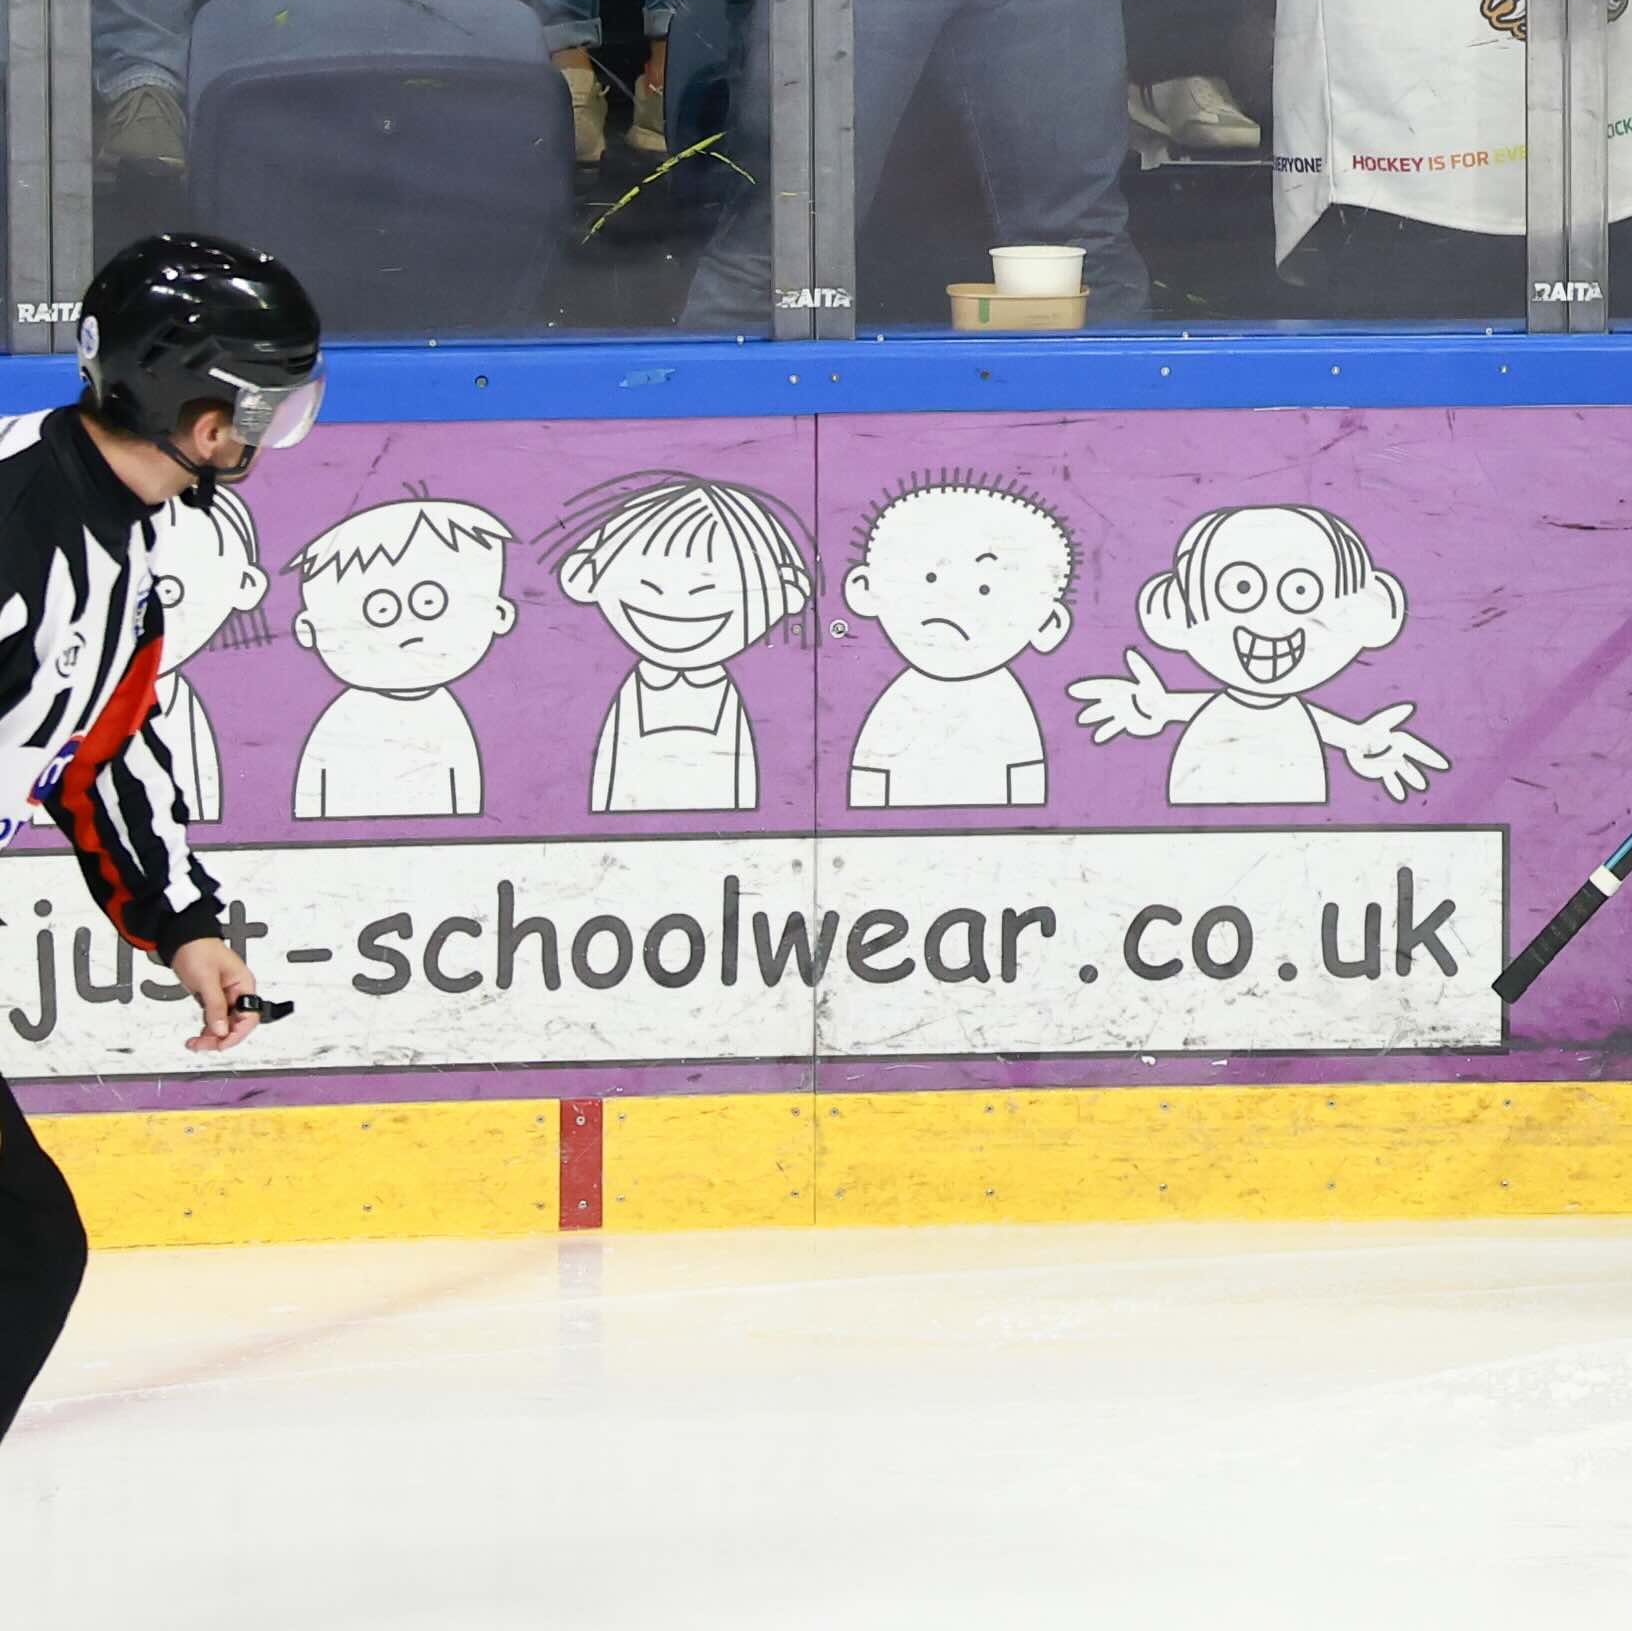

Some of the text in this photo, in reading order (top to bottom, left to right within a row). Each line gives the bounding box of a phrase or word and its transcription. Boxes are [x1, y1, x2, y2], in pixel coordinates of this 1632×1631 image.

[1273, 156, 1323, 174] ERYONE
[1352, 143, 1528, 173] HOCKEY IS FOR EVE
[1531, 281, 1605, 302] RAITA
[8, 865, 1459, 1044] jut-schoolwear.co.uk
